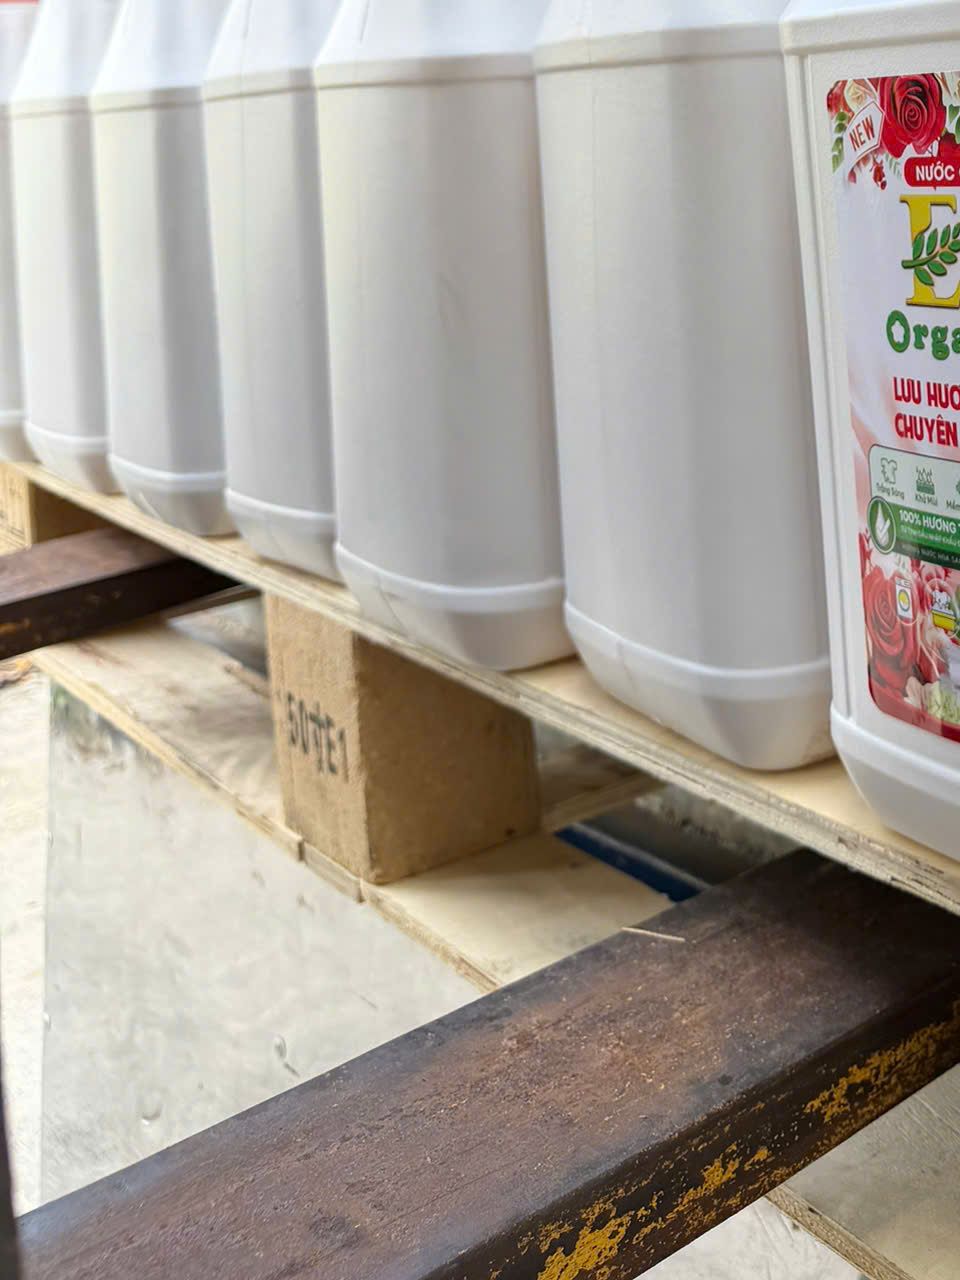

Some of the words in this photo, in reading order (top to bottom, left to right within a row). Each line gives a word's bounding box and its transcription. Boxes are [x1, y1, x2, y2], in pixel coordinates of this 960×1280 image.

[848, 118, 876, 151] NEW
[915, 160, 955, 182] NƯỚC
[894, 412, 958, 448] CHUYÊN
[899, 509, 921, 526] 100%
[922, 514, 957, 534] HƯƠNG
